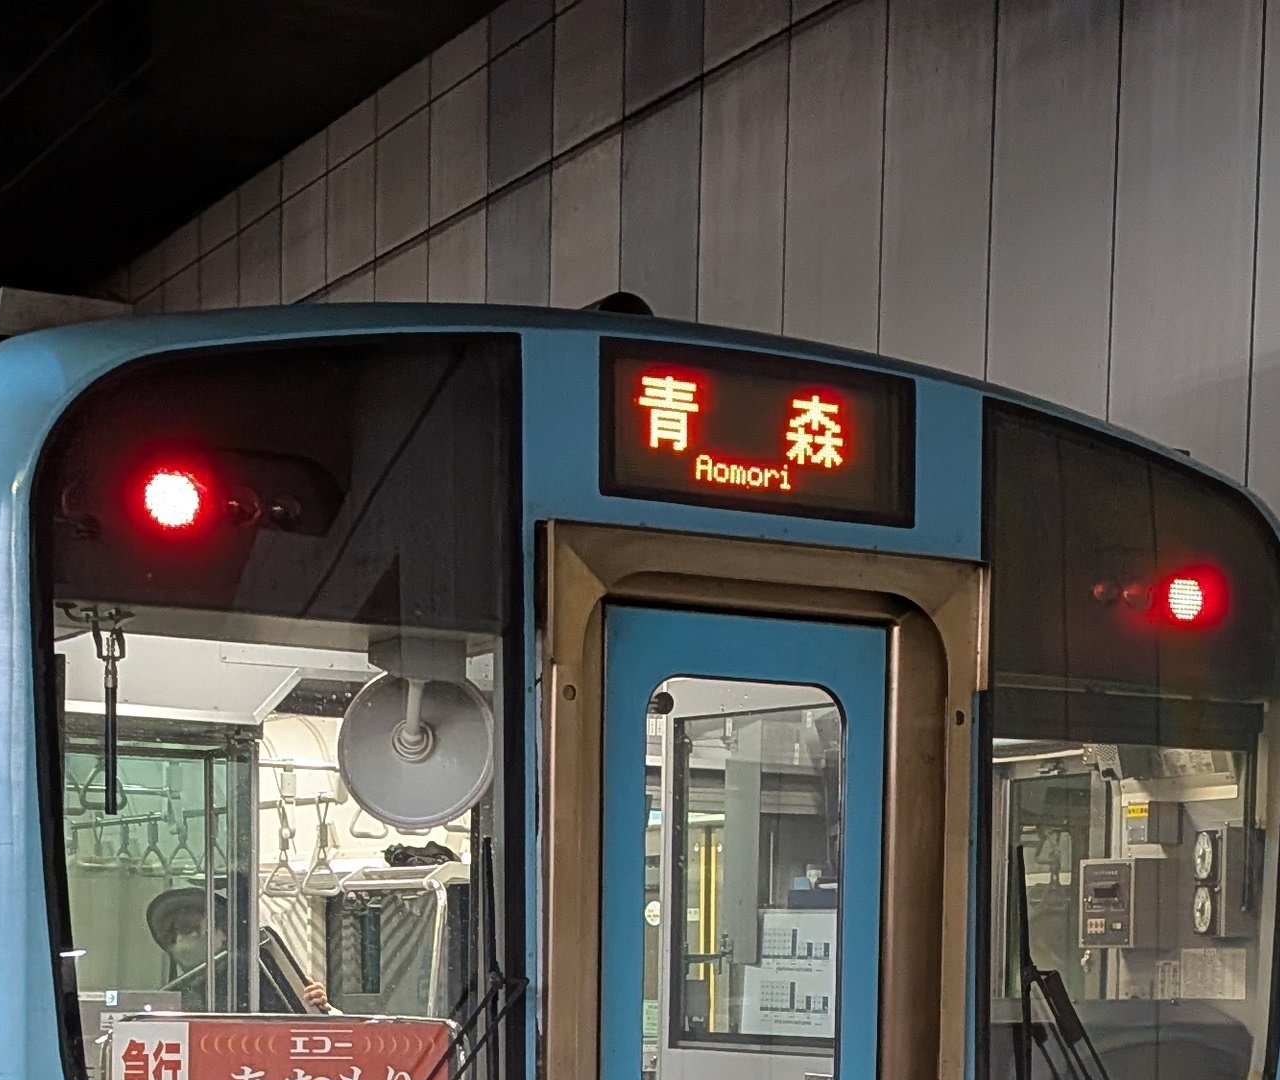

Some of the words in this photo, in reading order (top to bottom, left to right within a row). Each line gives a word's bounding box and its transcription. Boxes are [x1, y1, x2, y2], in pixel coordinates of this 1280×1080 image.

[638, 375, 844, 467] 青森
[695, 454, 791, 490] Aomori
[289, 1036, 353, 1053] エコー
